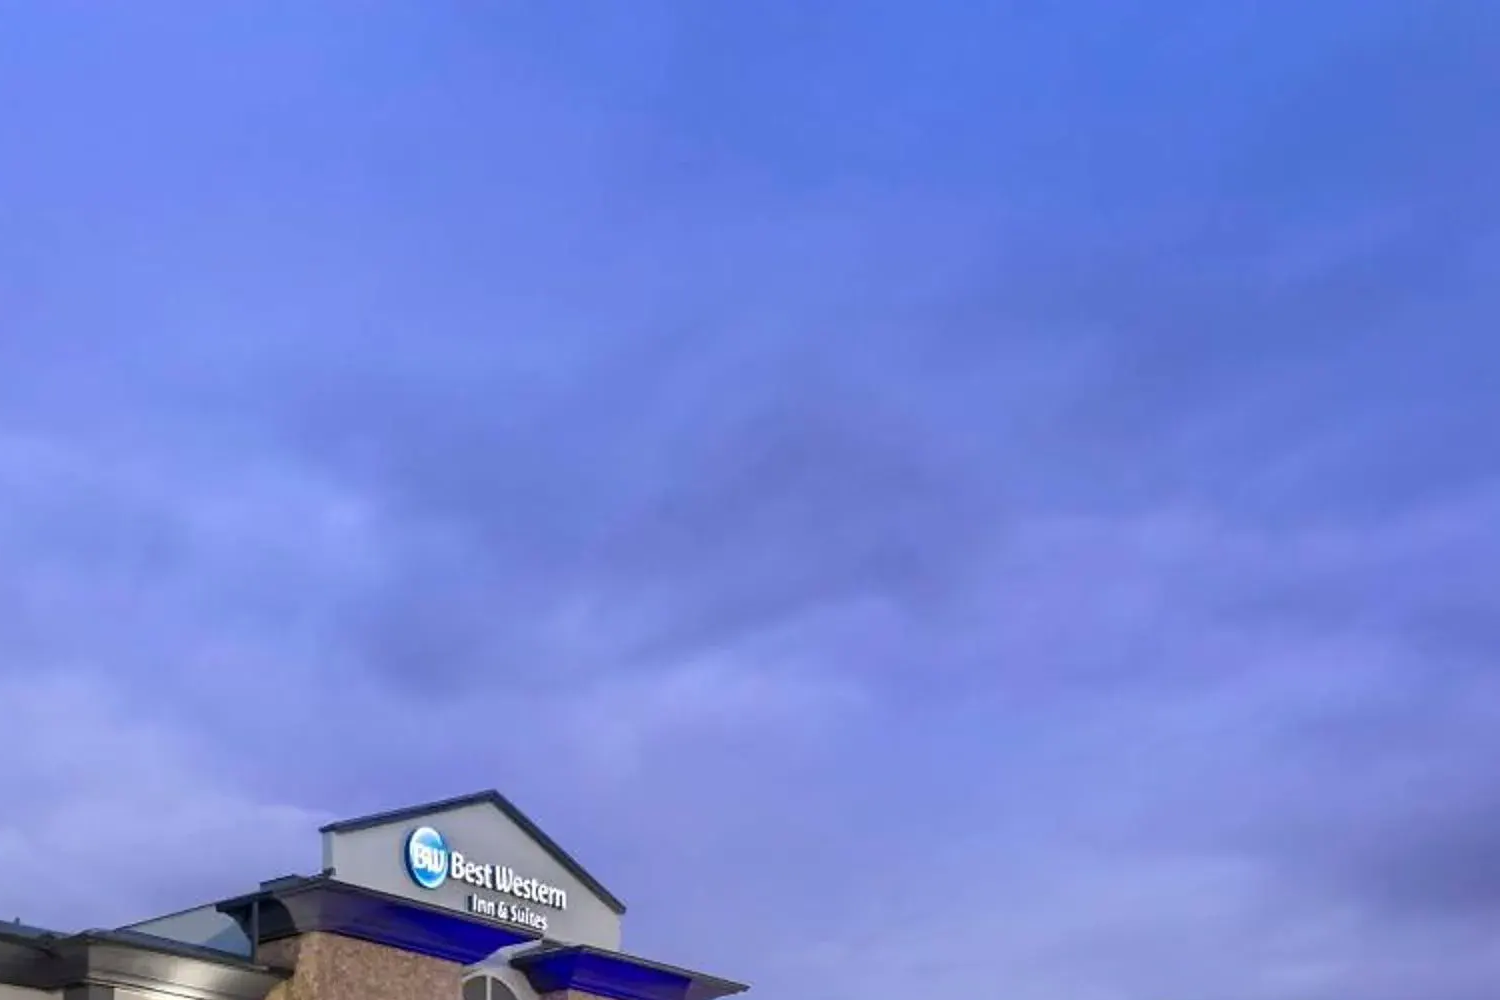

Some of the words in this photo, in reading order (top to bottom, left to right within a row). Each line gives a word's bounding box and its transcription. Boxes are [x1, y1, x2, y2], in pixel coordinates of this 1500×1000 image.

[413, 843, 445, 873] BW
[451, 850, 492, 889] Best
[495, 864, 567, 910] Western
[472, 892, 495, 917] Inn
[497, 901, 508, 920] &
[510, 904, 548, 931] Suites
